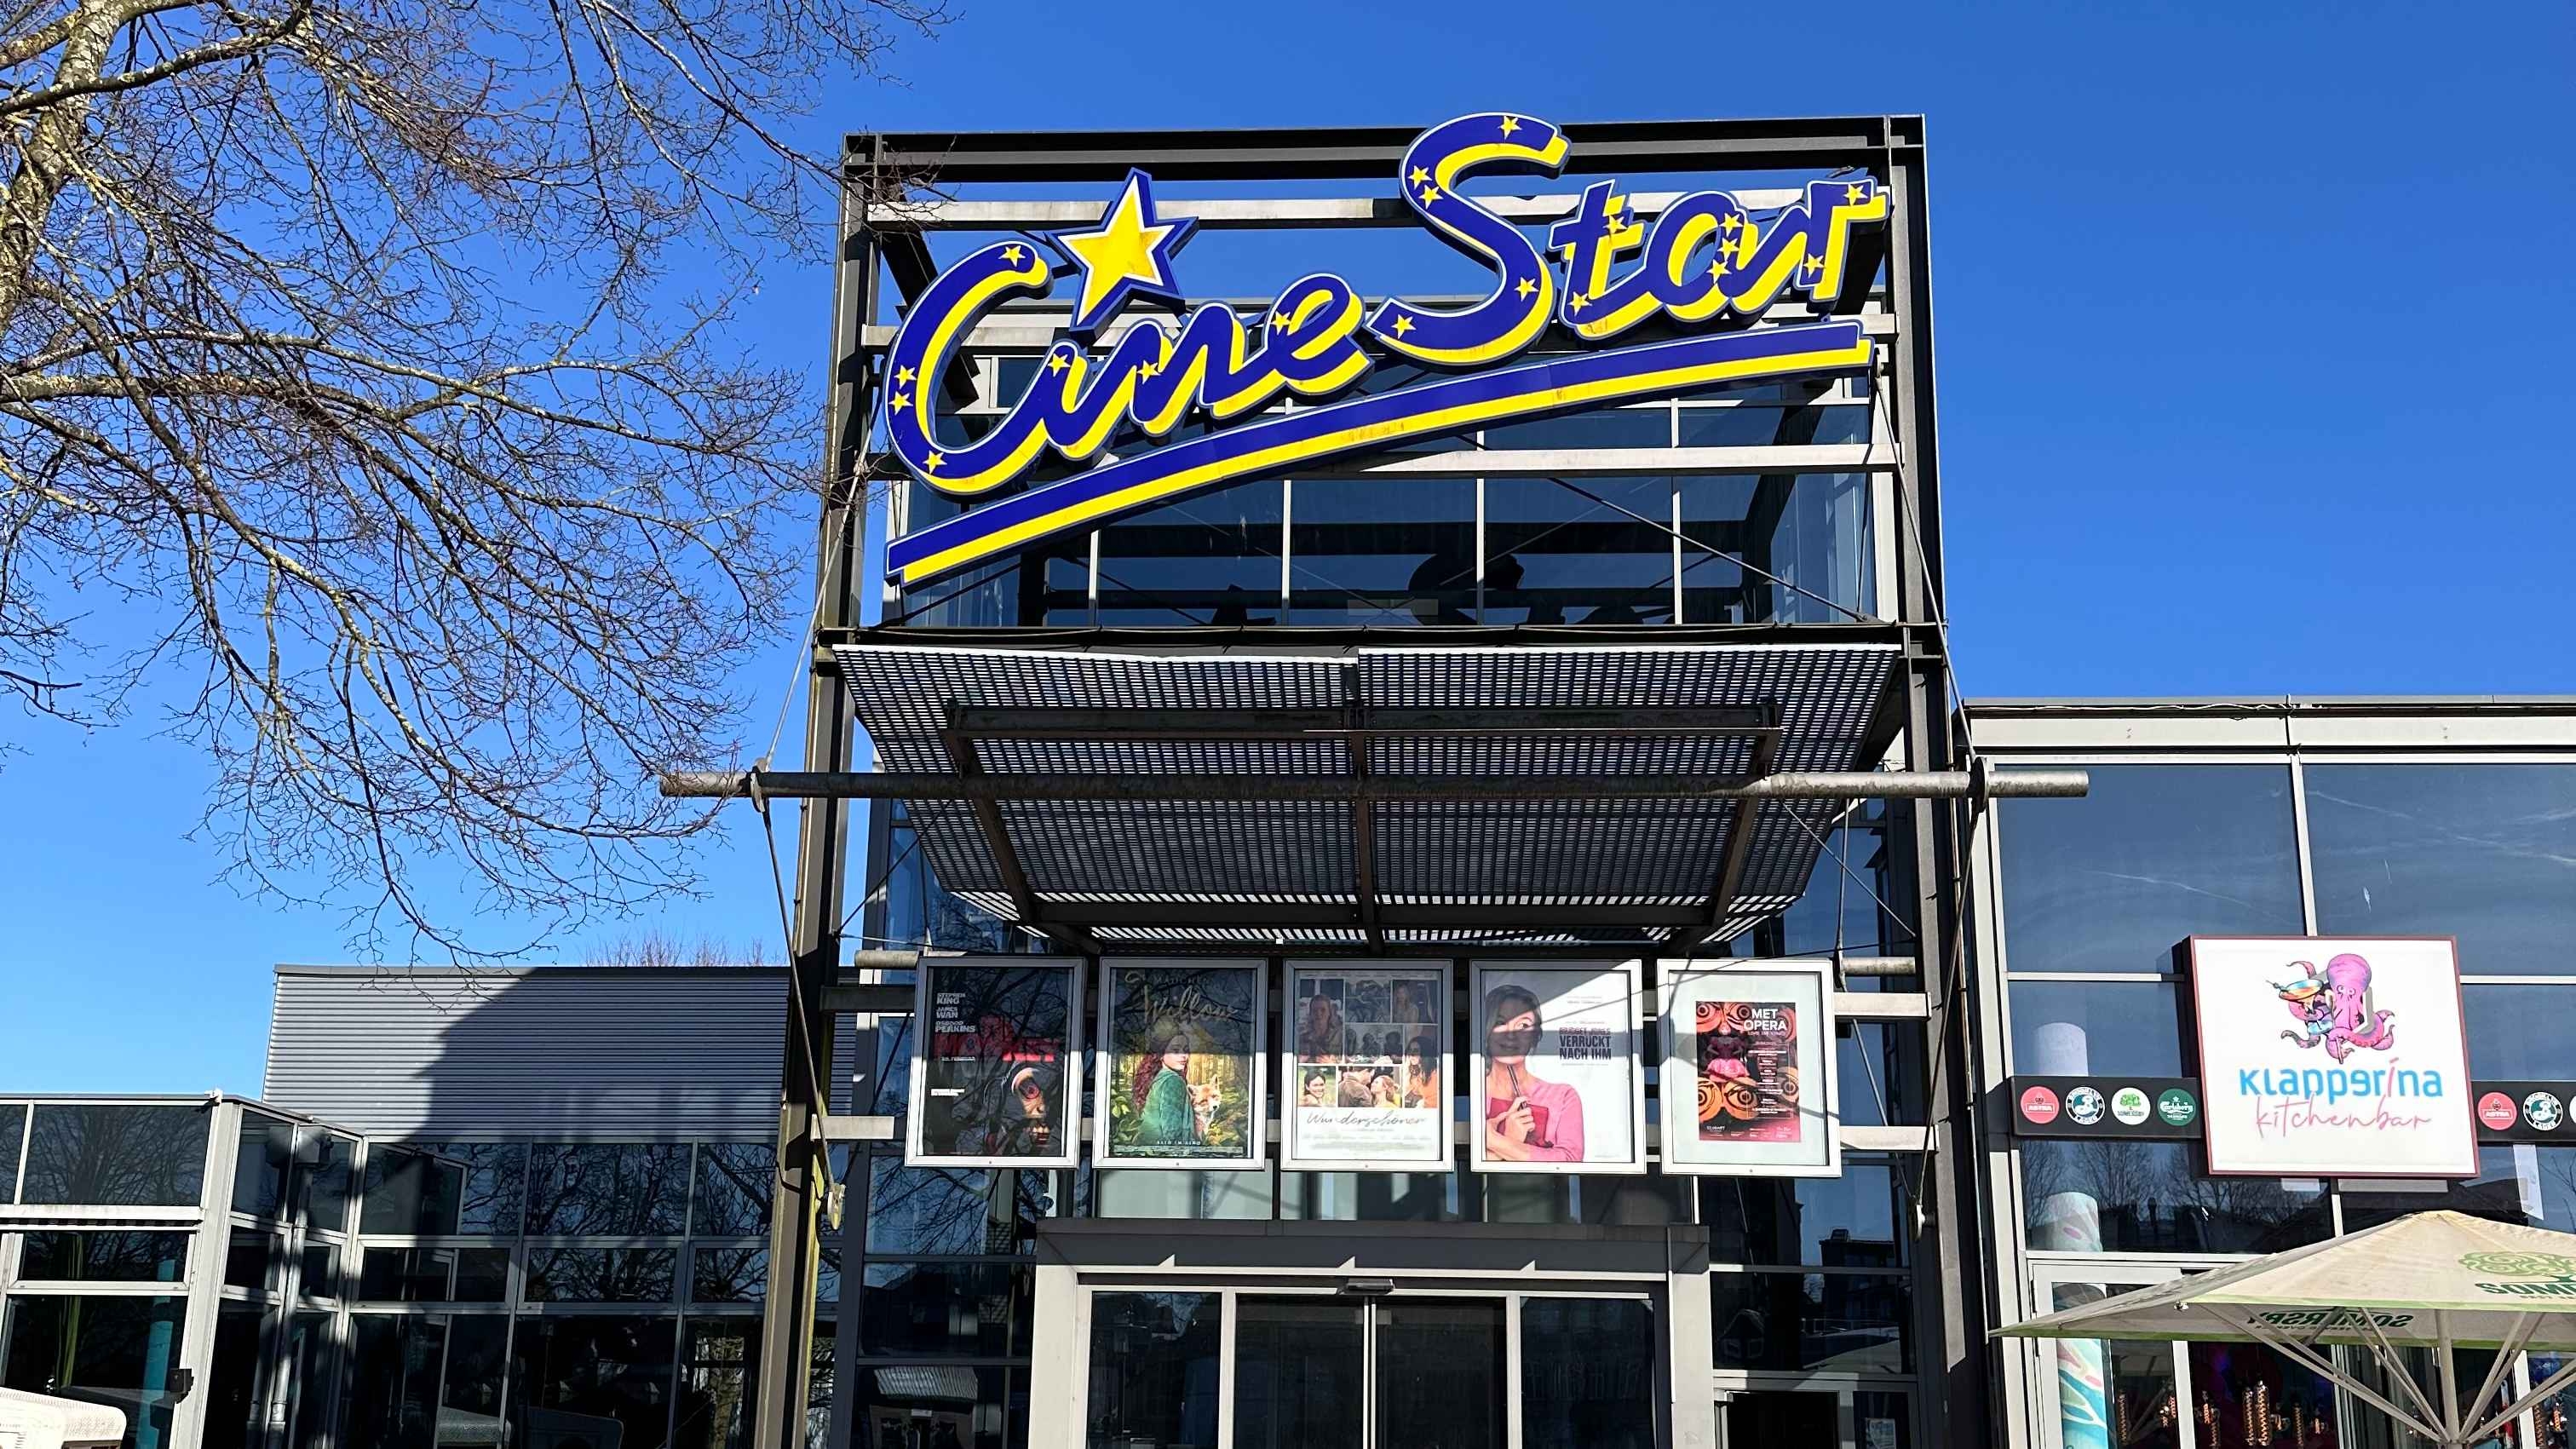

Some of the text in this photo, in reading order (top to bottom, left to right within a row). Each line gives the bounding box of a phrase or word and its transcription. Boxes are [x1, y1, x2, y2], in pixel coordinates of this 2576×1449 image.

[1751, 1008, 1779, 1019] MET
[934, 1025, 976, 1033] PERKINS
[1743, 1020, 1787, 1031] OPERA
[1559, 1048, 1612, 1060] NACH IHM
[2256, 1091, 2432, 1140] kitchenbar
